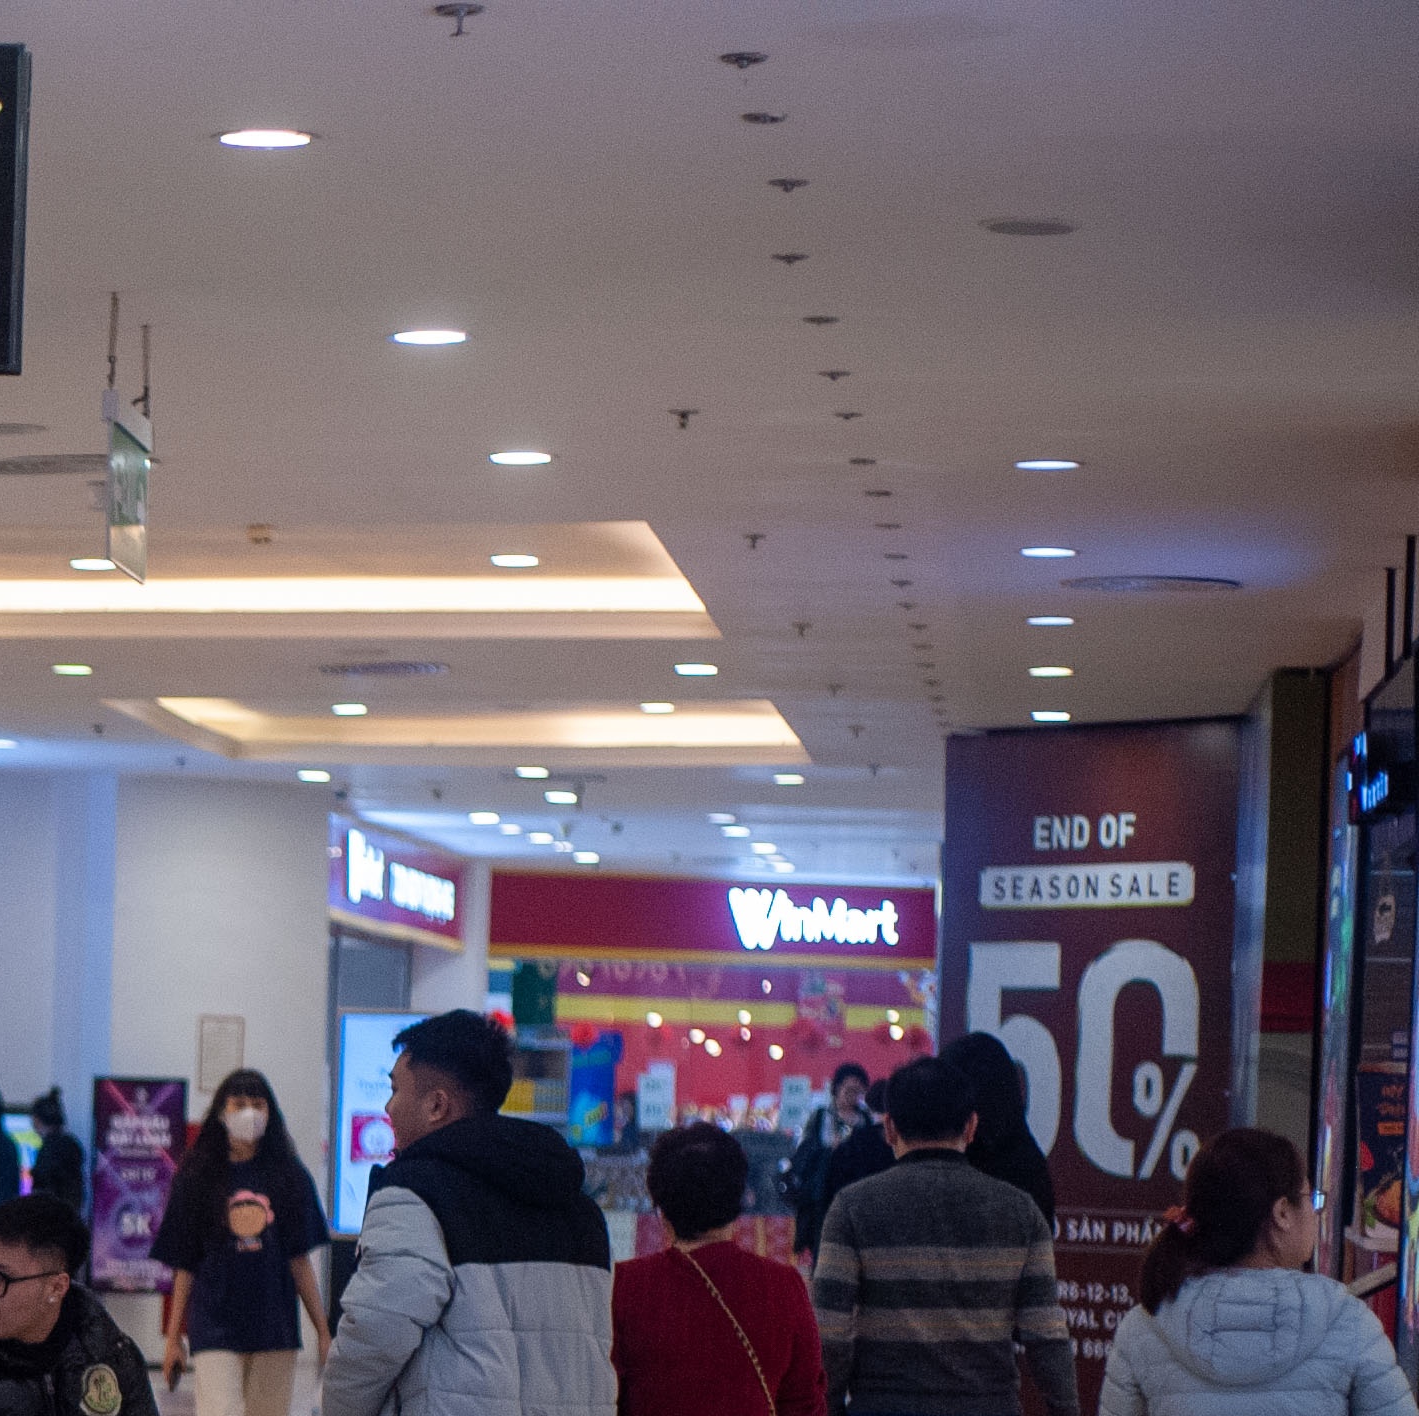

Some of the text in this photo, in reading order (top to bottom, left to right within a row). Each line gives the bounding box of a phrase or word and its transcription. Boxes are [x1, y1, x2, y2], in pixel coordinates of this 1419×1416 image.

[1033, 813, 1137, 850] END OF
[993, 871, 1180, 902] SEASON SALE
[727, 886, 900, 951] WinMart
[967, 938, 1201, 1182] 50%
